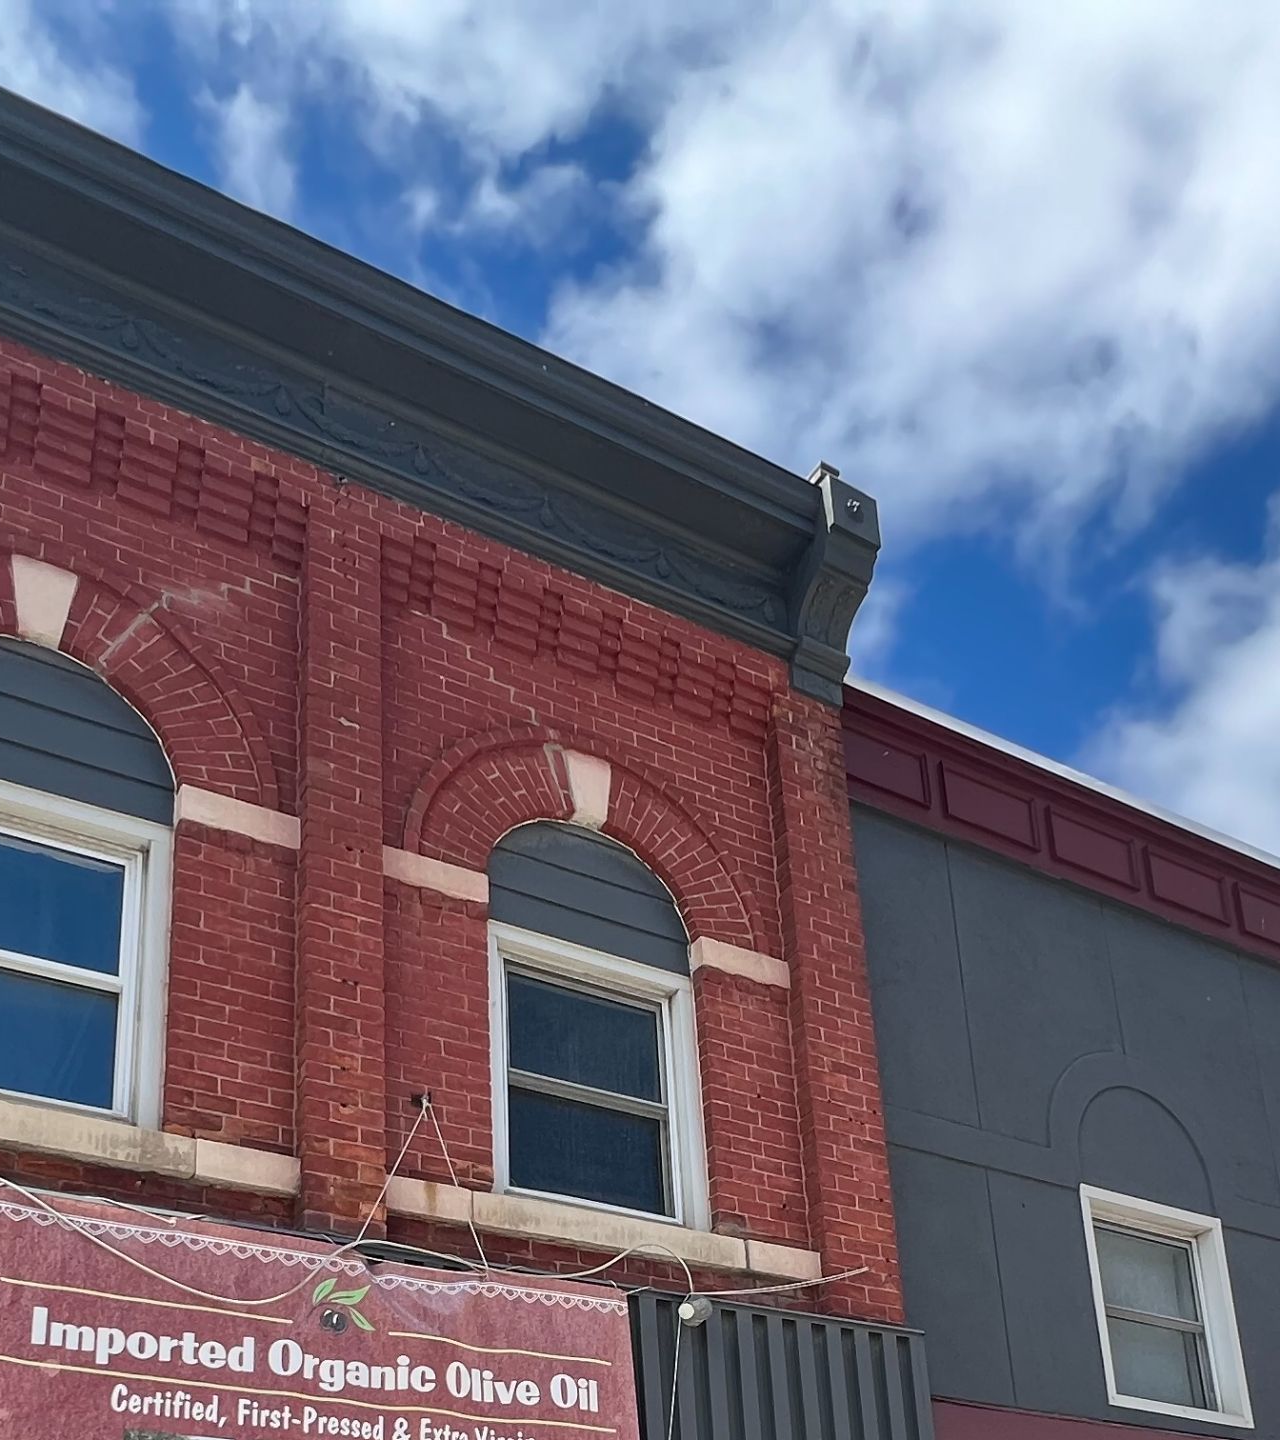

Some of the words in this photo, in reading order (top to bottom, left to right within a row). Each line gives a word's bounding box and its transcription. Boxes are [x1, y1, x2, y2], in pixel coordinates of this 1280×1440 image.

[30, 1306, 255, 1372] Imported
[267, 1339, 437, 1392] Organic
[445, 1361, 541, 1405] Olive
[550, 1373, 598, 1412] Oil
[110, 1383, 227, 1428] Certified,
